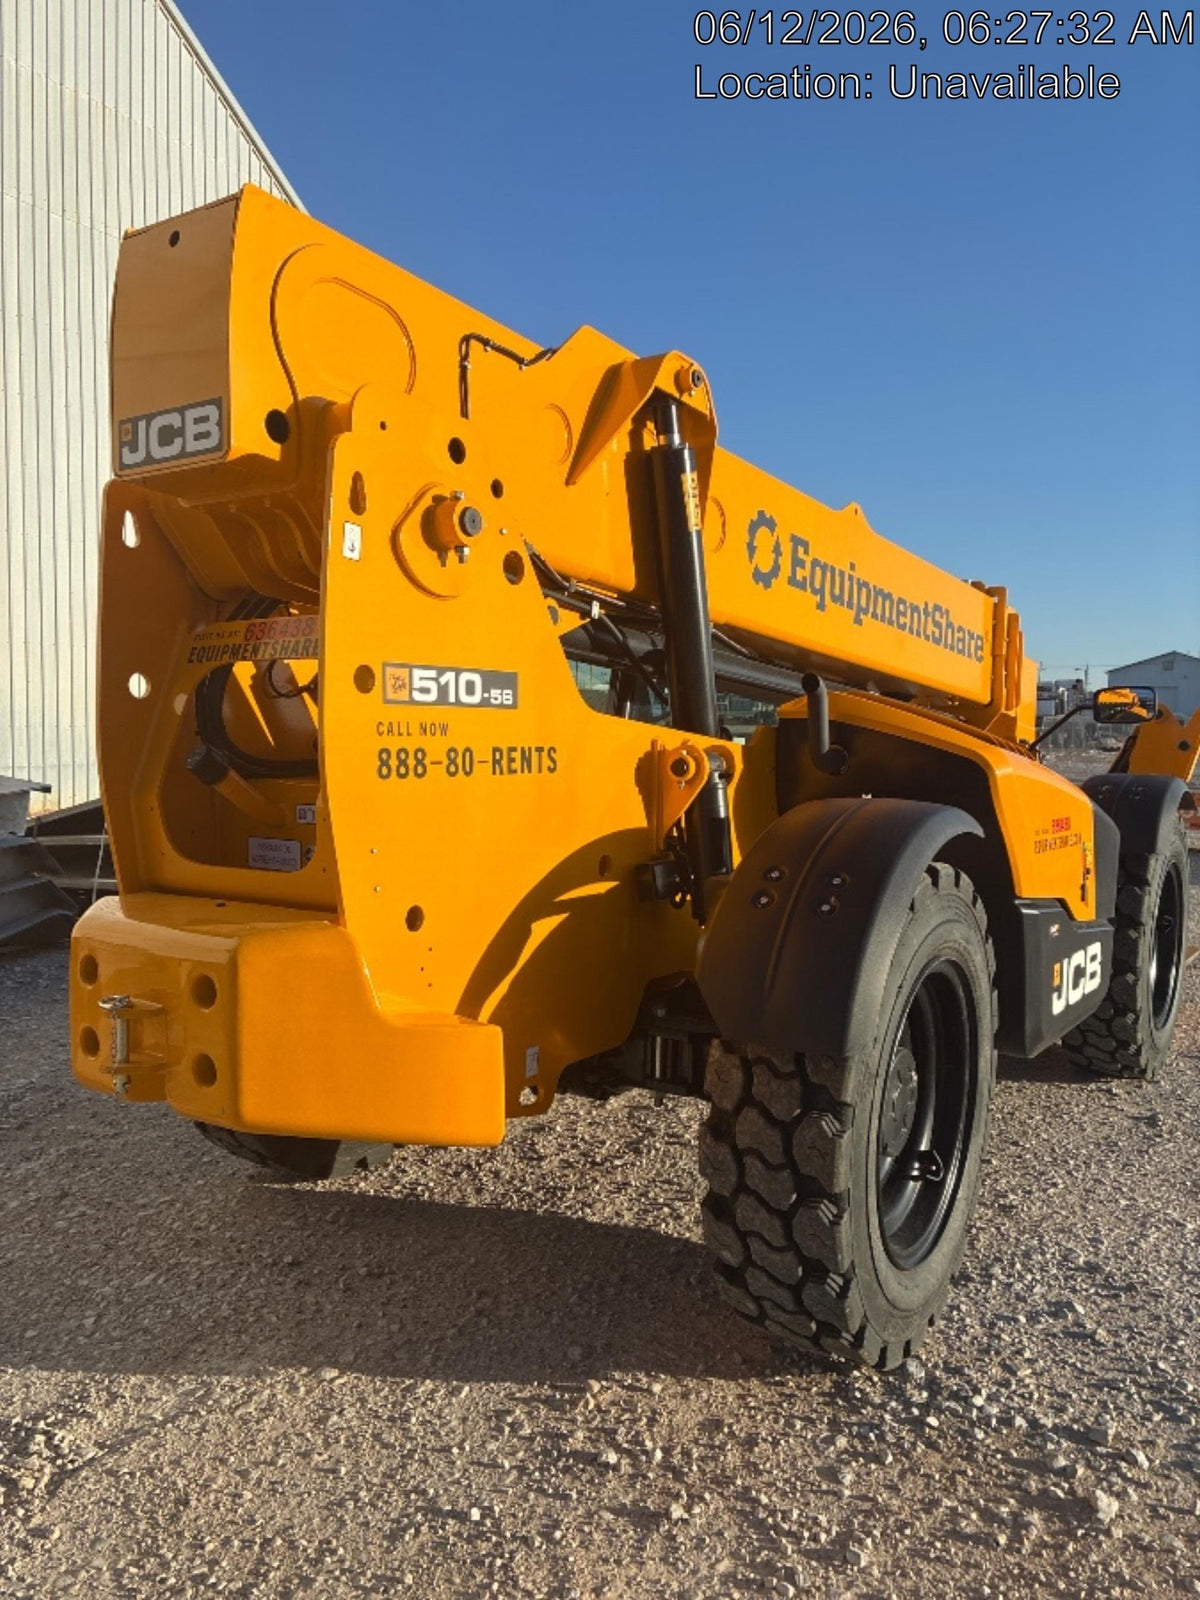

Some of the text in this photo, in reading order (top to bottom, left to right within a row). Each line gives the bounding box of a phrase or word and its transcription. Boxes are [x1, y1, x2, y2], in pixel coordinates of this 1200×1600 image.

[121, 404, 220, 465] JCB
[787, 532, 984, 664] EquipmentShare
[244, 616, 315, 642] 636438
[376, 721, 449, 737] CALL NOW
[377, 746, 558, 780] 888-80-RENTS
[1052, 941, 1101, 1015] JCB
